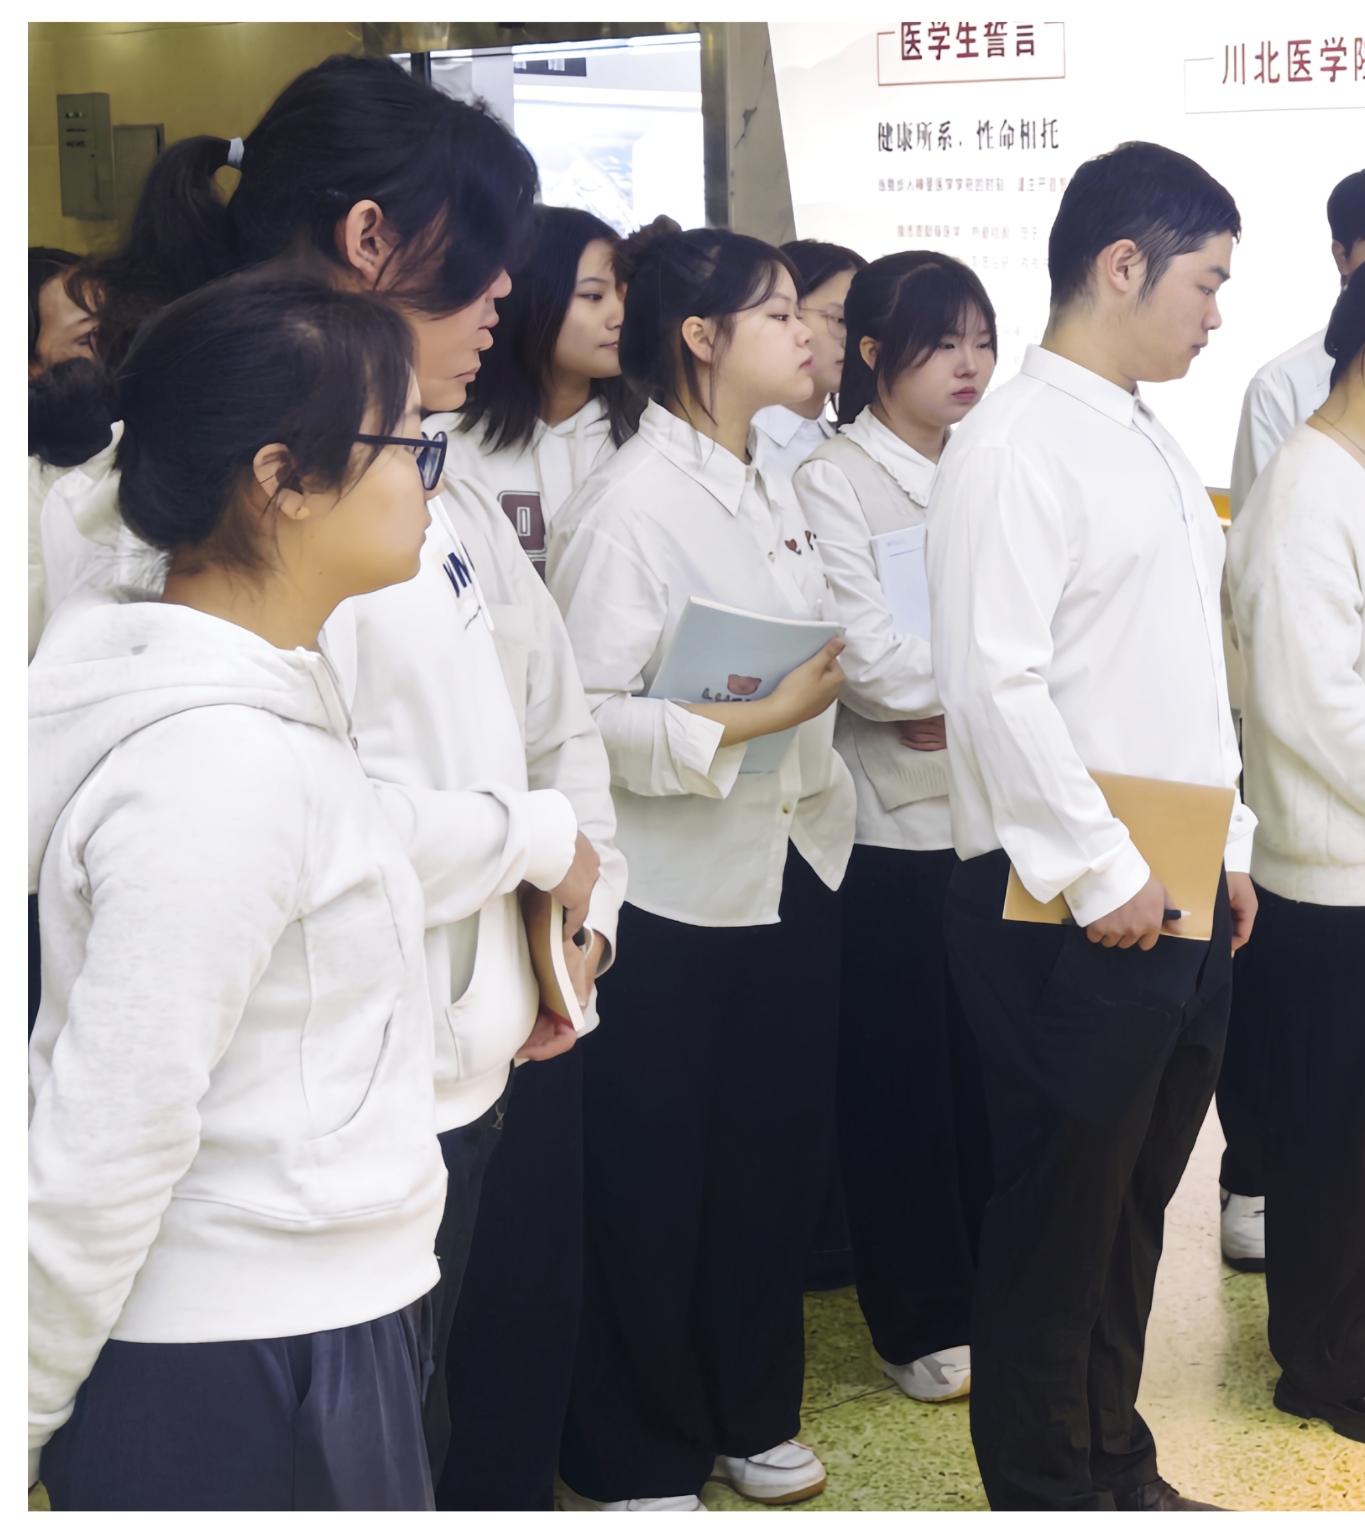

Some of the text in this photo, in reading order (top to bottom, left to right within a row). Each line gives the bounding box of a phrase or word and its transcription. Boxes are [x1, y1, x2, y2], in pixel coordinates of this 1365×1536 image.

[901, 21, 1035, 61] 医学生誓言
